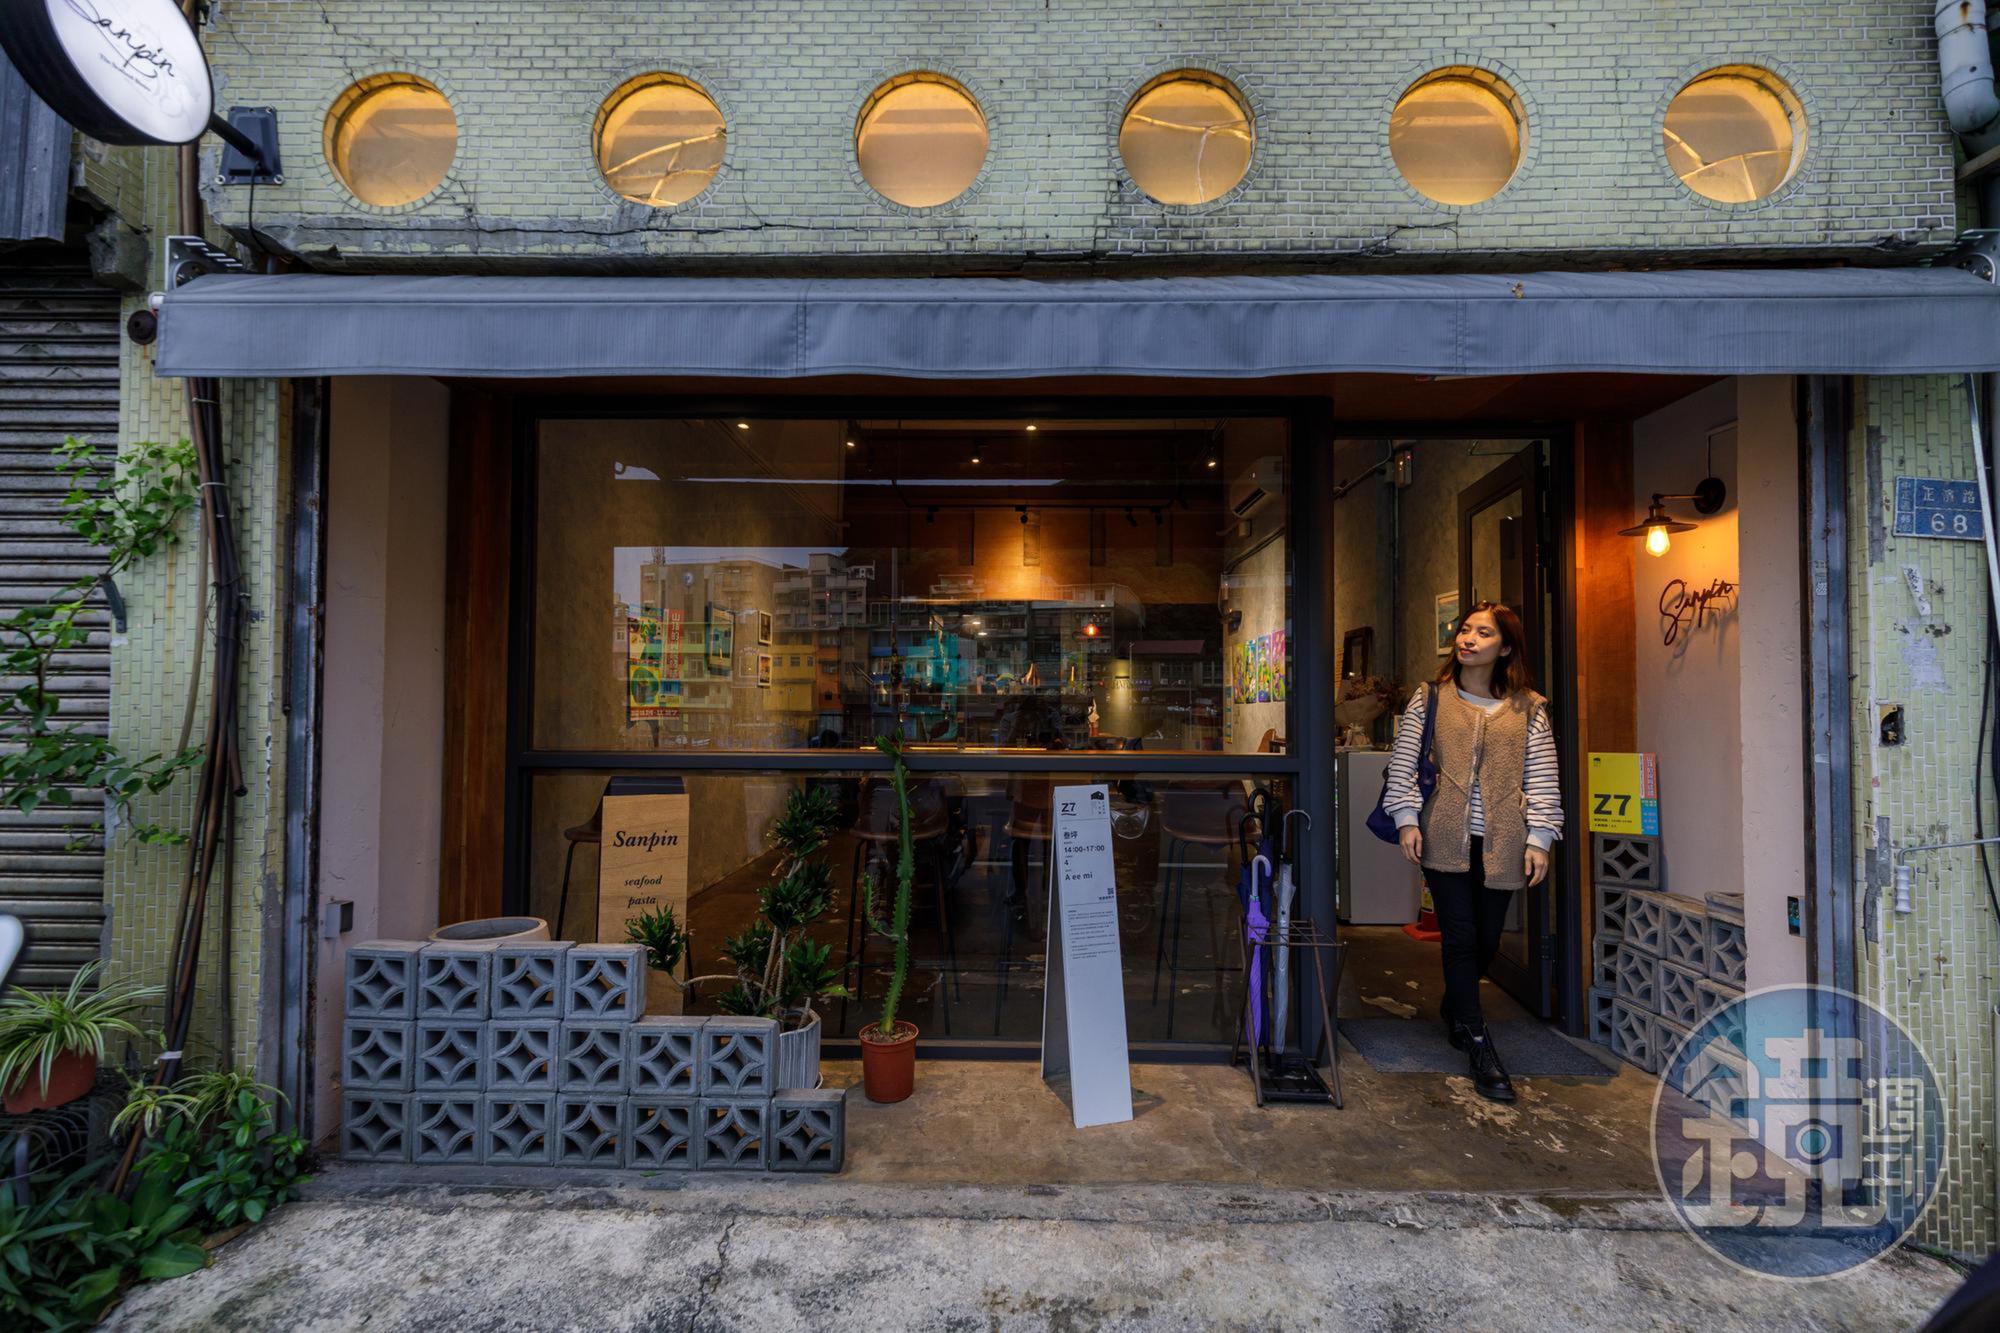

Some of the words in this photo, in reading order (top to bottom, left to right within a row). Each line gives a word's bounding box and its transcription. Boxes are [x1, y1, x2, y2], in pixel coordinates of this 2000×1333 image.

[1931, 513, 1968, 534] 68
[1061, 802, 1077, 812] Z7
[1593, 793, 1632, 816] Z7
[612, 830, 679, 853] Sanpin
[624, 875, 663, 888] seafood
[627, 896, 657, 909] pasta
